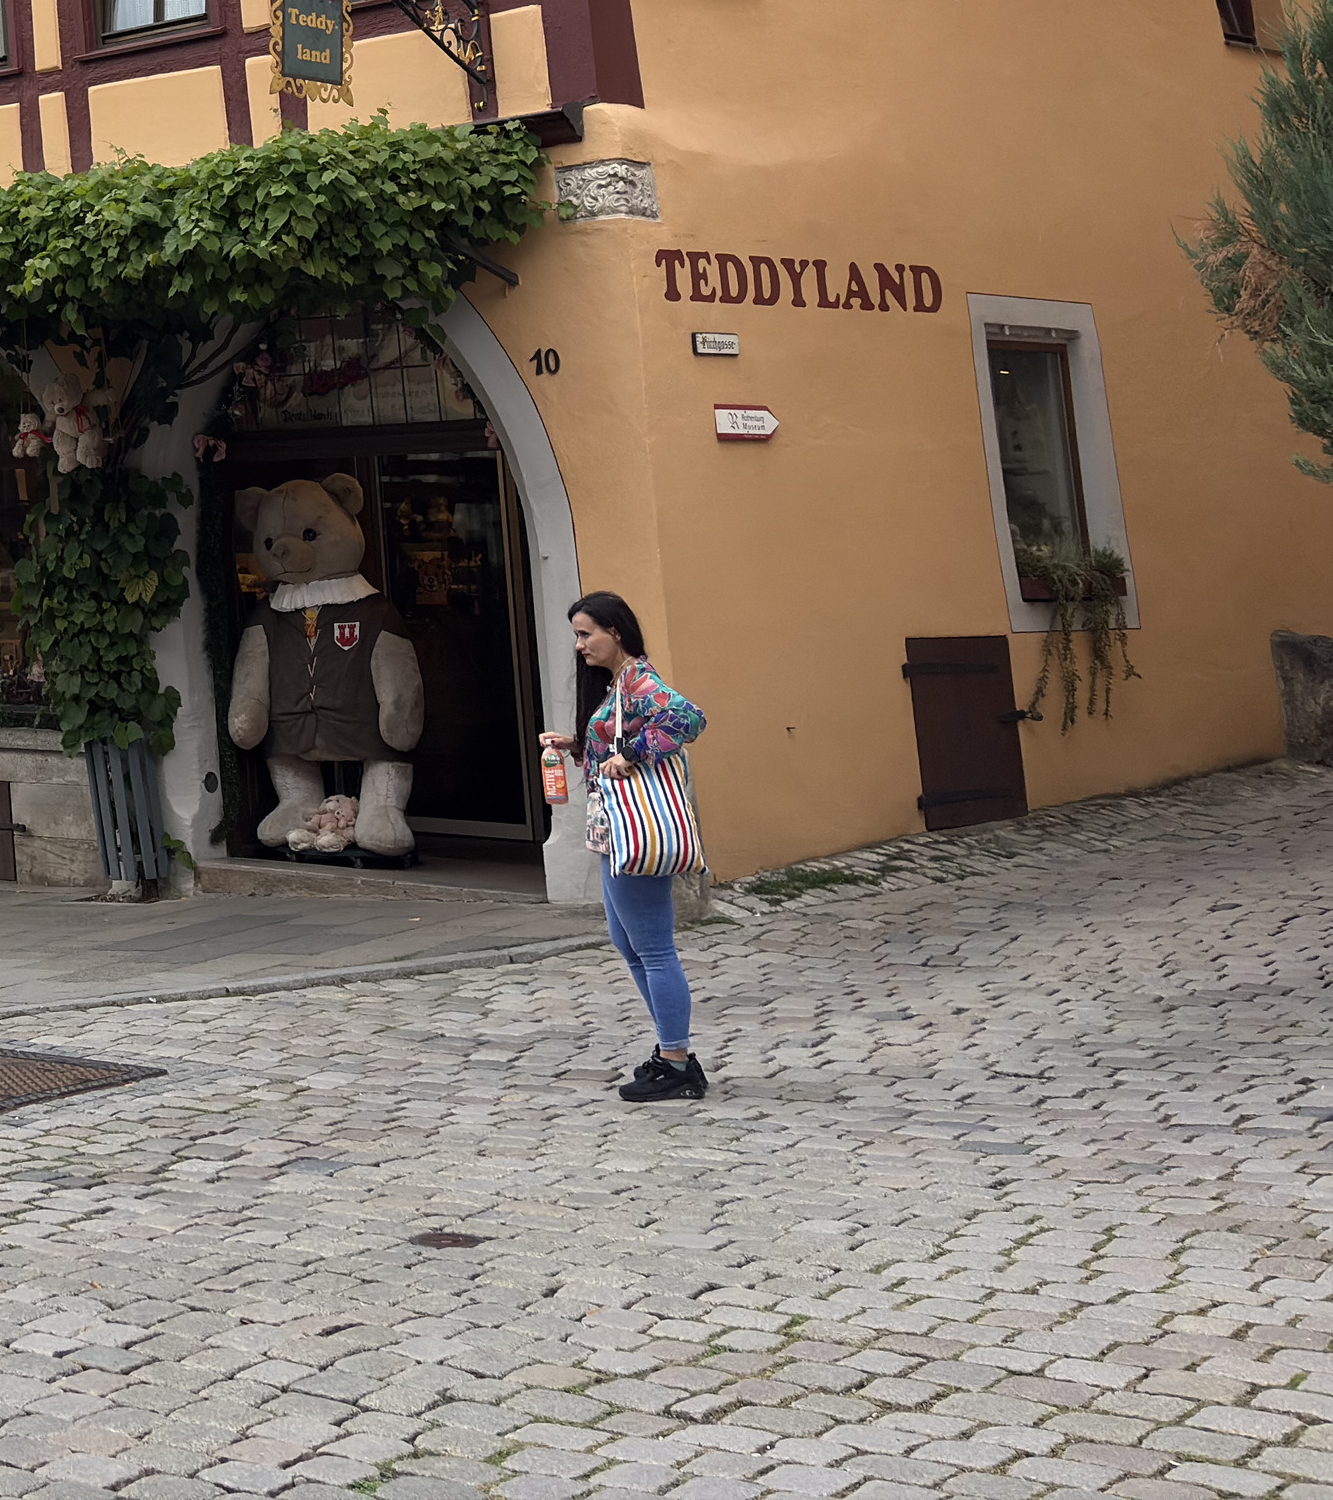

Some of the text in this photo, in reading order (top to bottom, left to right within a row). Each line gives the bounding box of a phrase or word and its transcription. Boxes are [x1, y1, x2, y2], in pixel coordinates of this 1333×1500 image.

[297, 44, 331, 64] land
[655, 249, 943, 313] TEDDYLAND
[529, 348, 560, 376] 10
[742, 423, 766, 431] Museum
[545, 768, 557, 796] ACTIVE
